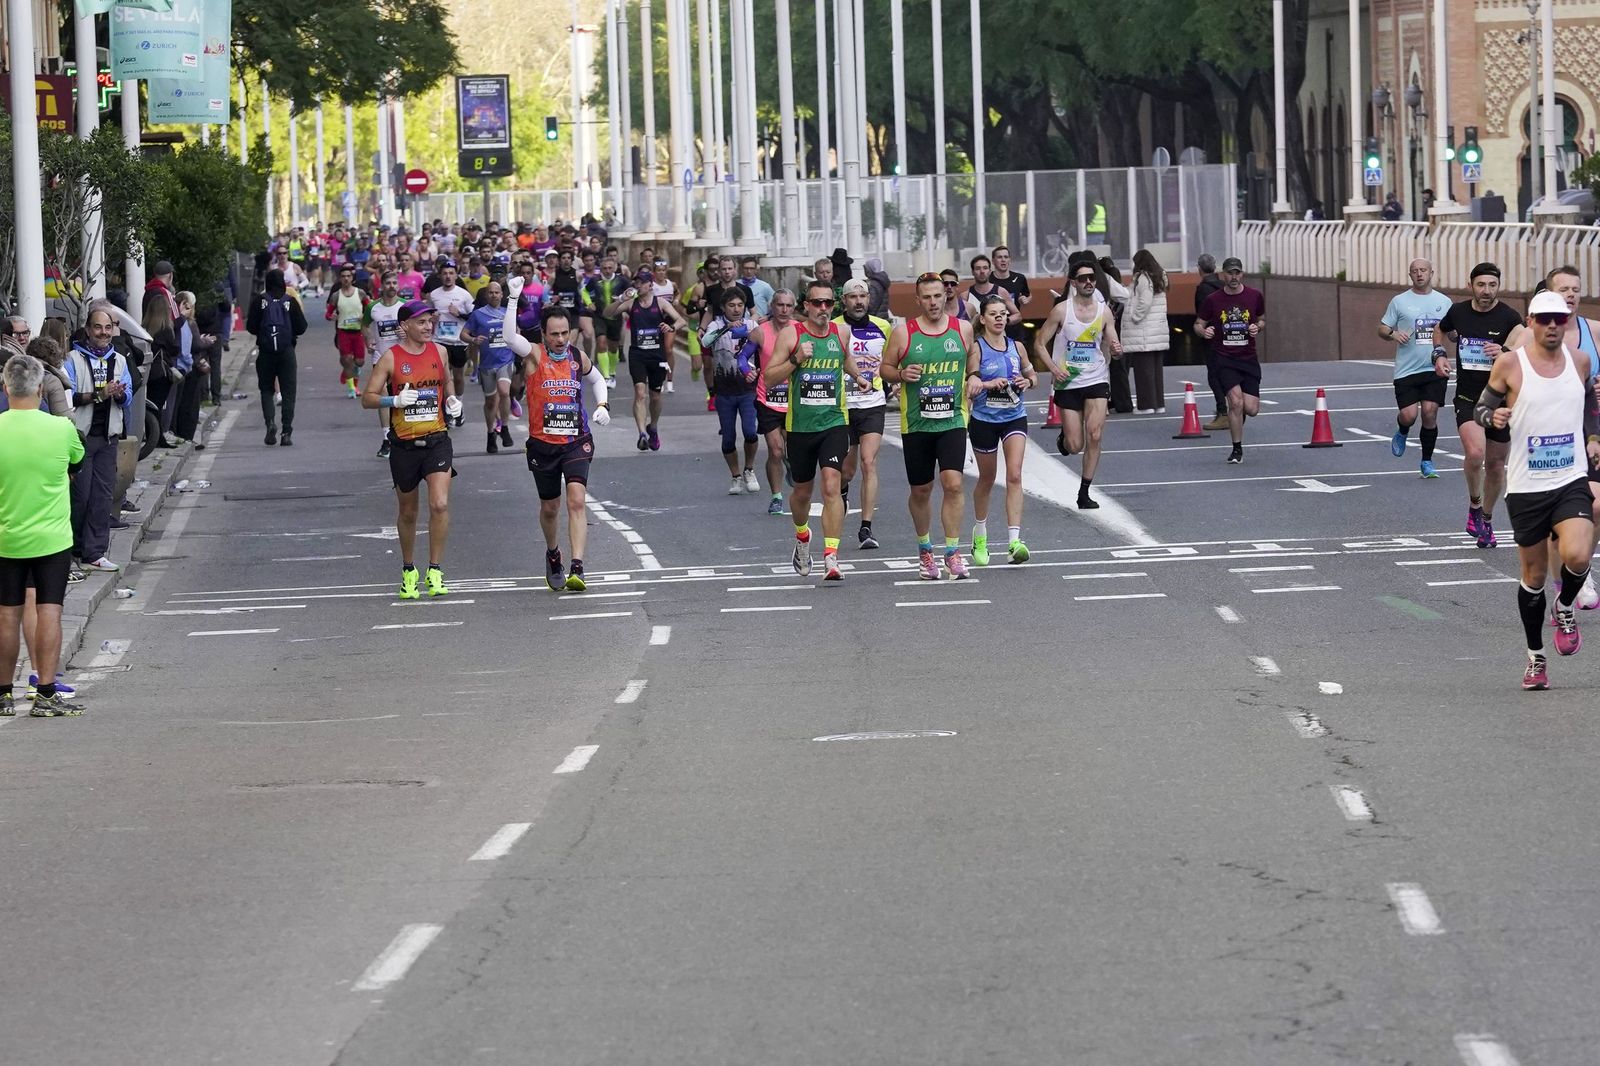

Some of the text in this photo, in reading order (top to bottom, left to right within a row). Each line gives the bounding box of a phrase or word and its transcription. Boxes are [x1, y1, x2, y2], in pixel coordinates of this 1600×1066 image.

[920, 361, 960, 375] IKILA
[936, 378, 956, 387] RUN
[806, 390, 830, 398] ANGEL
[416, 406, 439, 414] HIDALGO
[924, 402, 950, 412] ALVARO
[547, 420, 575, 429] JUANCA
[1543, 436, 1571, 446] ZURICH
[1528, 455, 1576, 470] MONCLOVA
